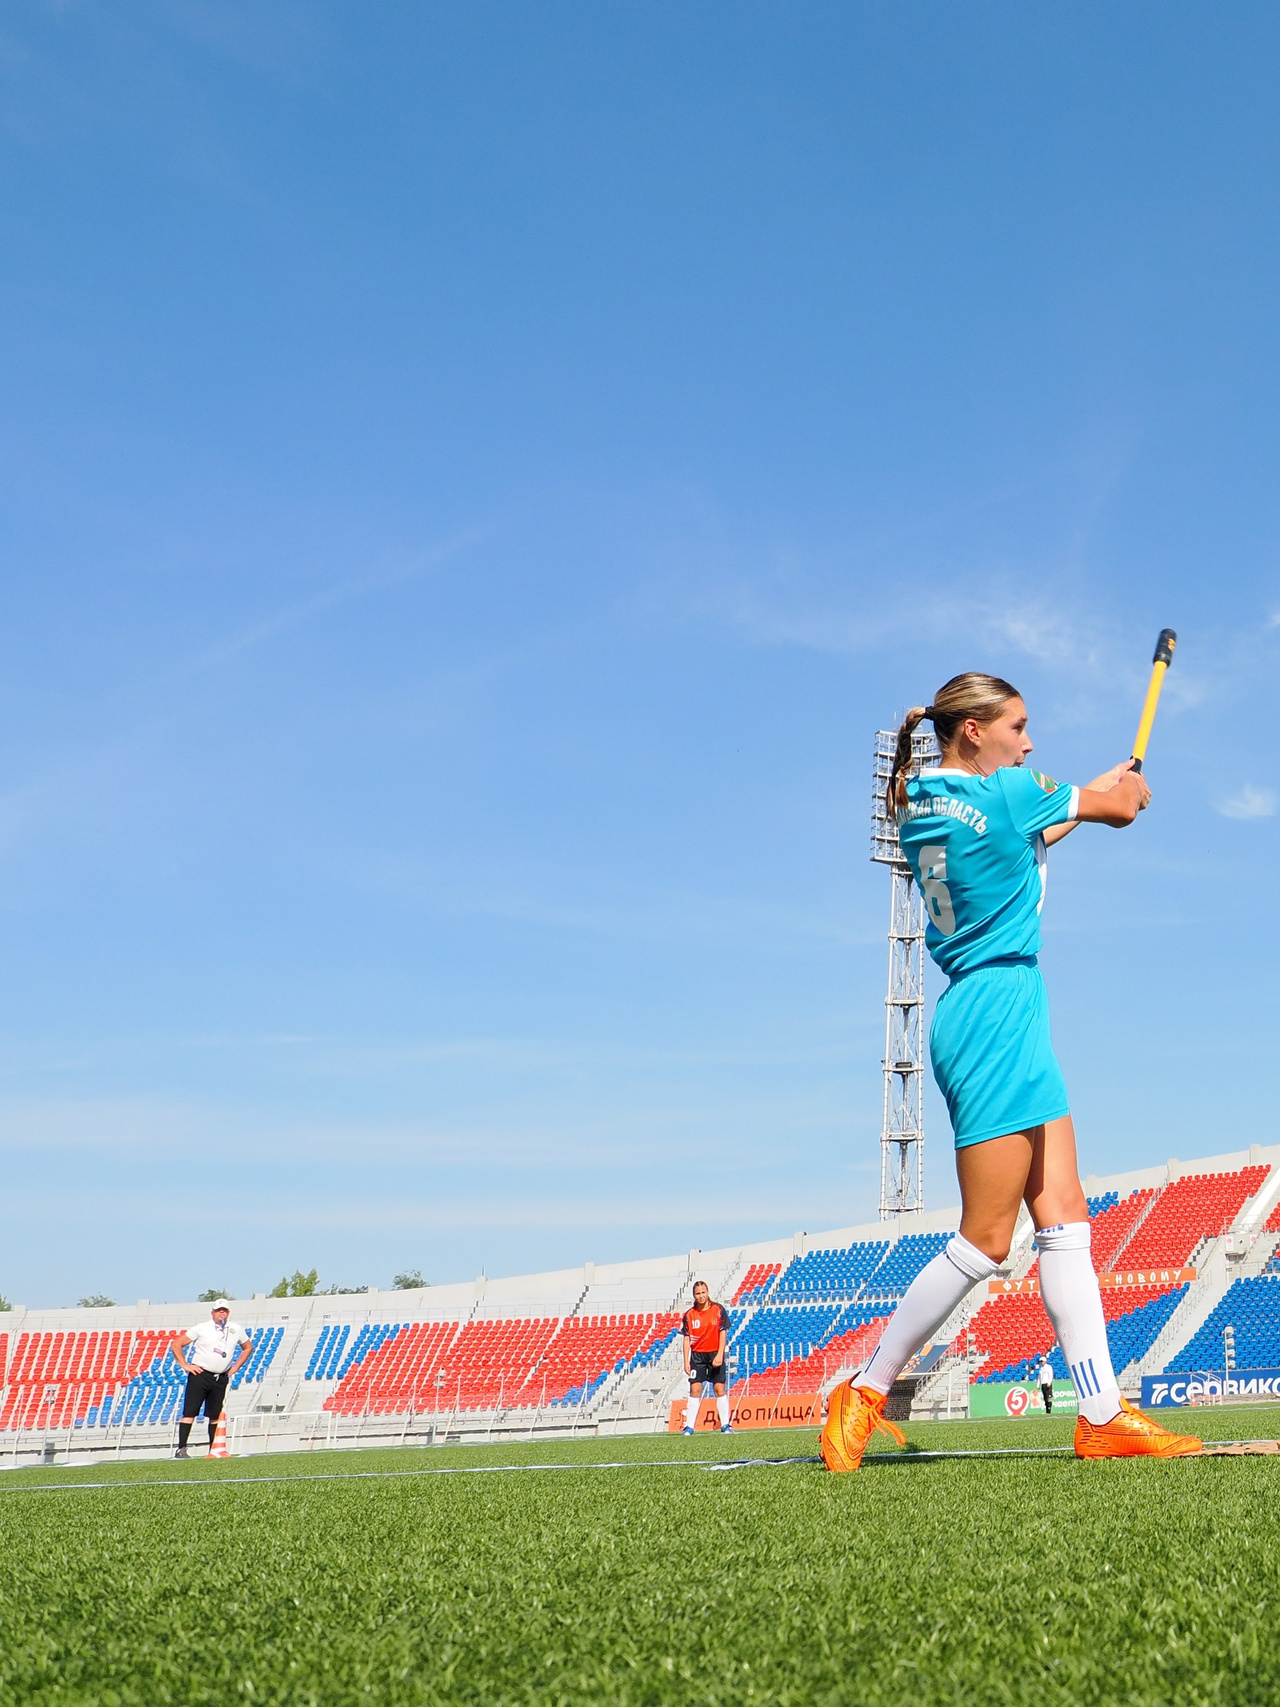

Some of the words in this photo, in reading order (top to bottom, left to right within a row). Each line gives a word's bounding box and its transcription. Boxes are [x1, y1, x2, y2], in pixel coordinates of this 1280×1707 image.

[933, 796, 988, 834] ОБЛАСТЬ
[918, 845, 956, 937] 6
[1002, 1280, 1036, 1292] ФУТ
[1104, 1269, 1182, 1285] -НОВОМУ
[691, 1319, 701, 1329] 10
[704, 1408, 751, 1425] ДДО
[755, 1405, 815, 1421] ПИЦЦА
